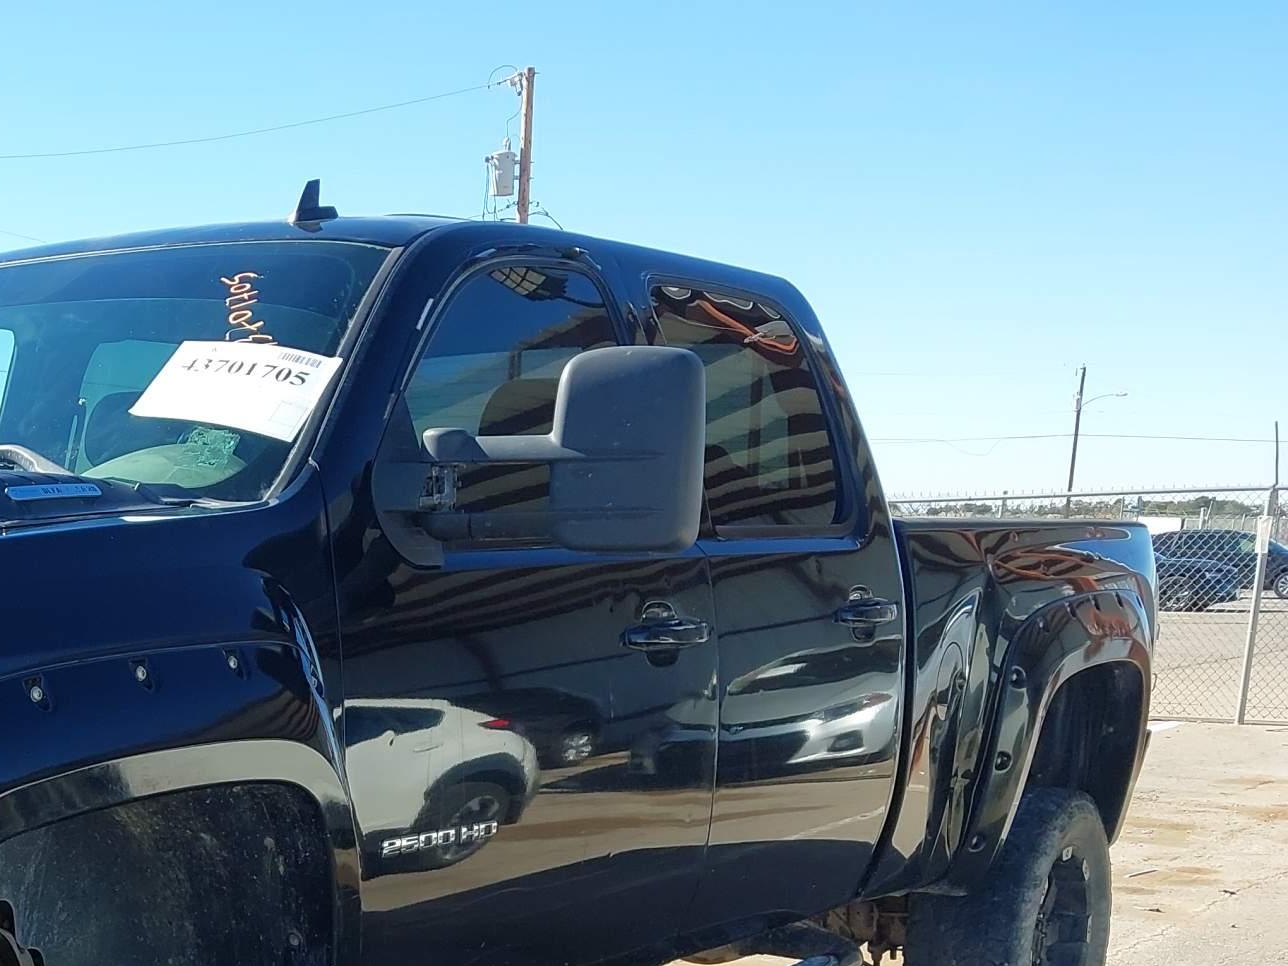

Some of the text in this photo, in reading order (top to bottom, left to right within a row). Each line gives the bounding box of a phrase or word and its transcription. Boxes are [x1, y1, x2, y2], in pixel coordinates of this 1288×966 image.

[220, 271, 279, 345] 3701705
[181, 357, 312, 386] 43701705
[381, 820, 499, 859] 2500 HD
